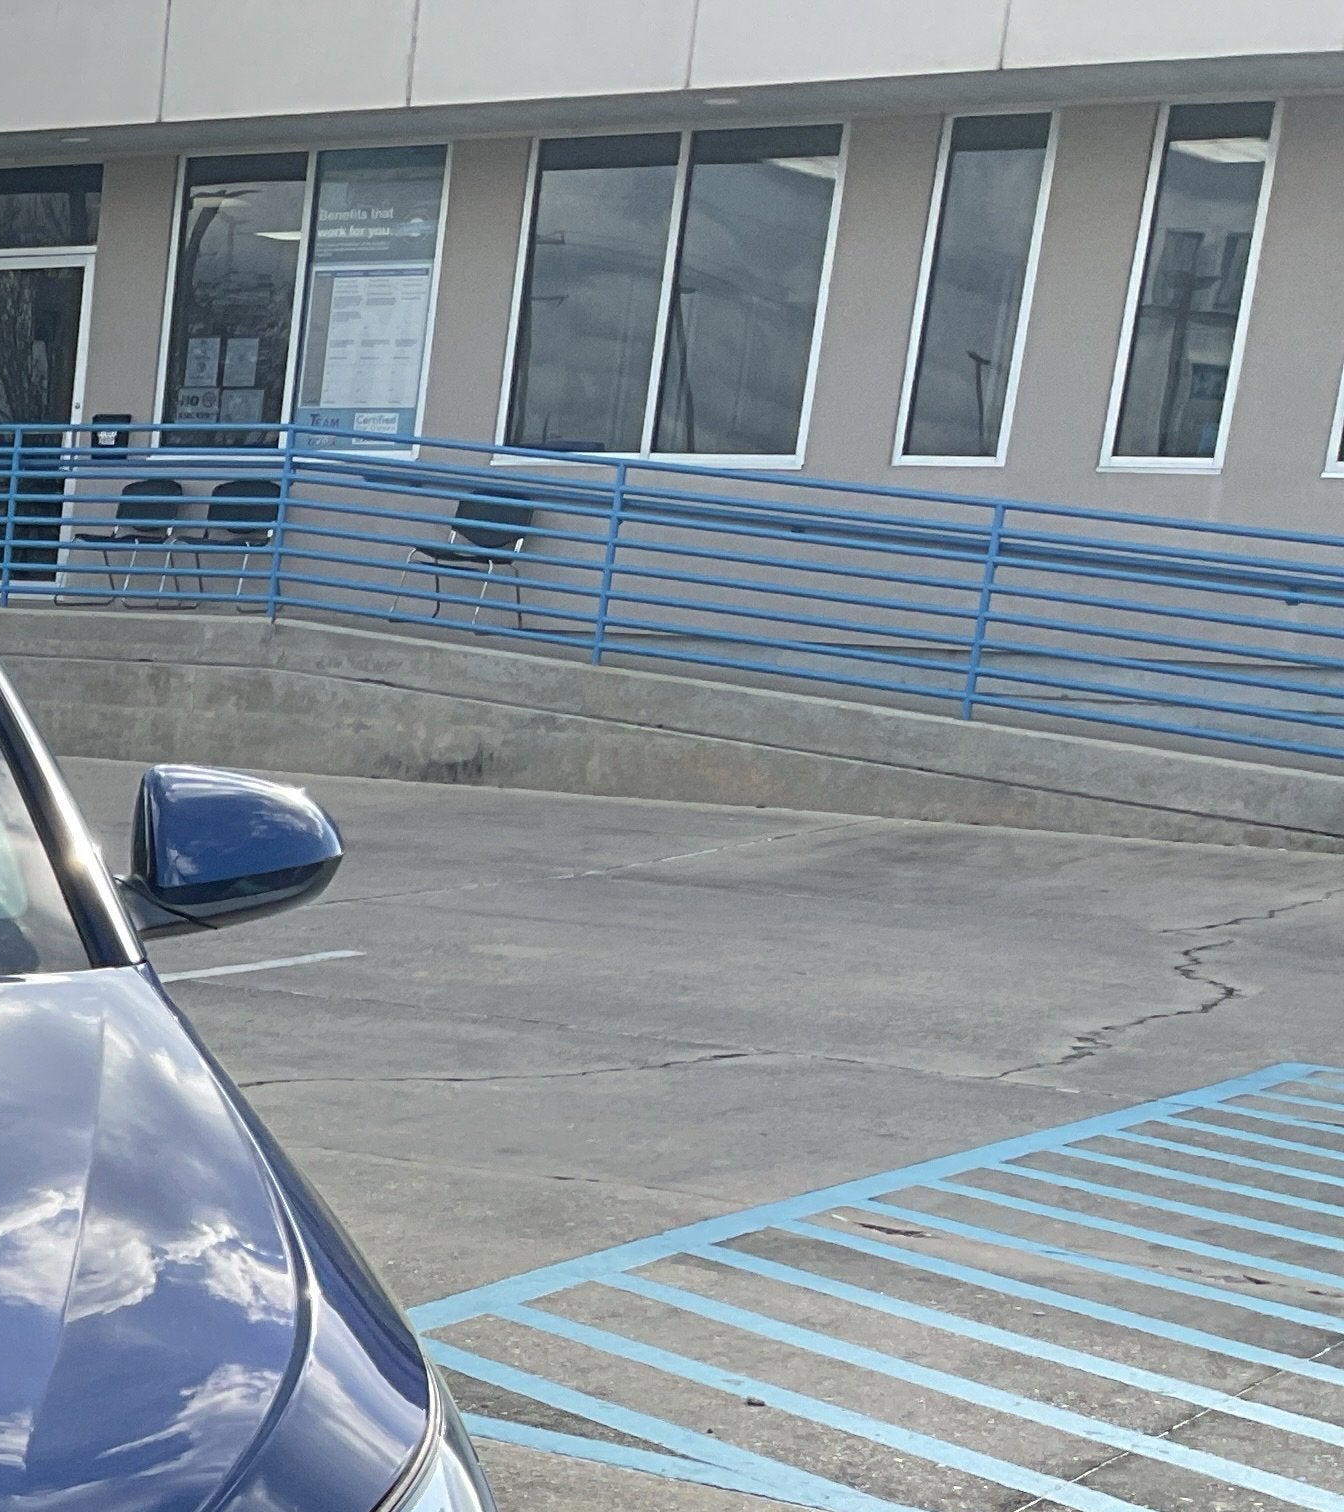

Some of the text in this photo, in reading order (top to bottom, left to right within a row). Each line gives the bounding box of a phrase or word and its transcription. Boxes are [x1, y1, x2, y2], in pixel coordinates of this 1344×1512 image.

[319, 207, 394, 221] Benefits that
[317, 226, 347, 238] work
[350, 225, 366, 237] for
